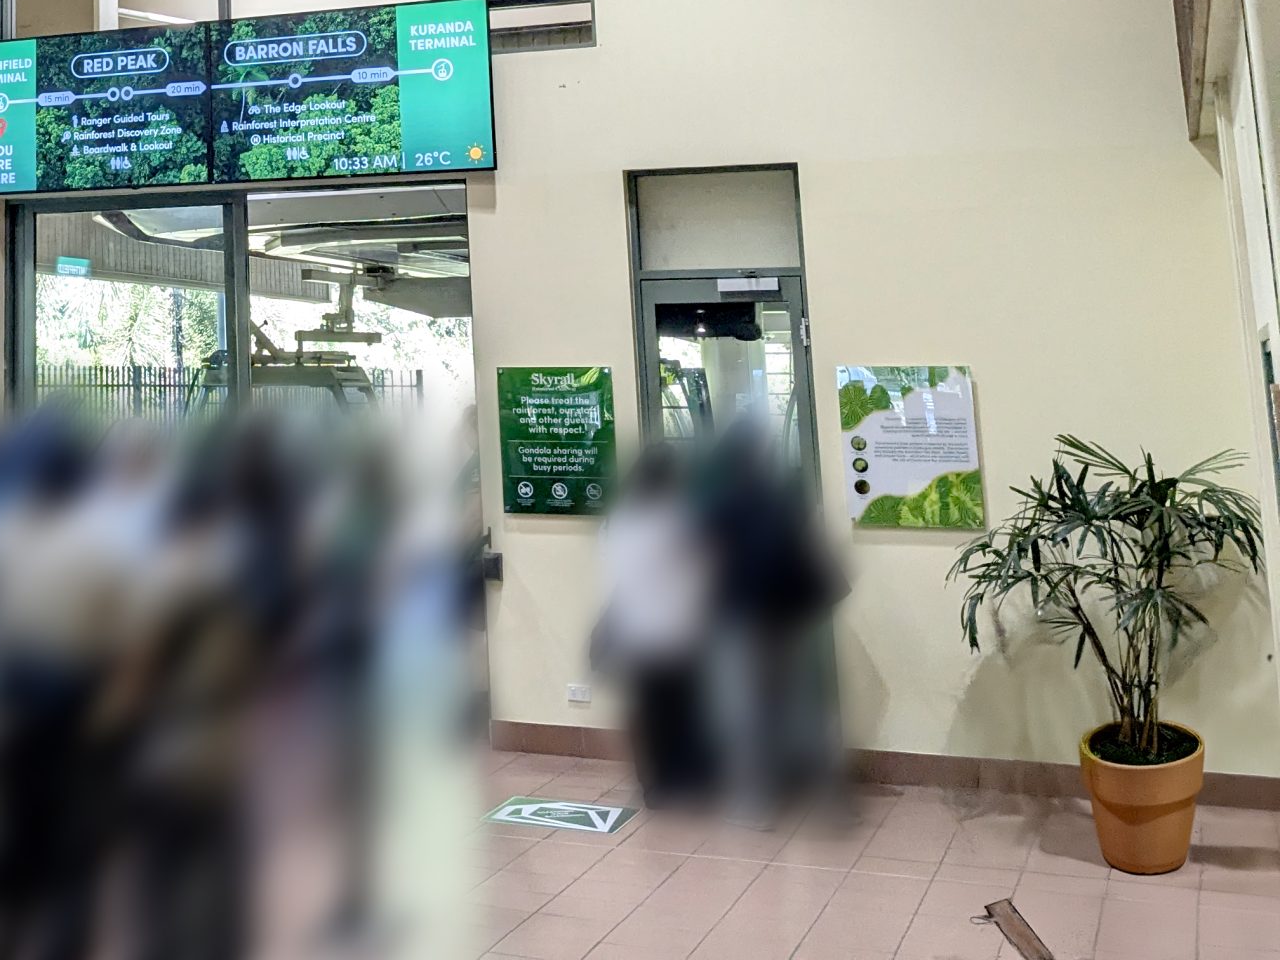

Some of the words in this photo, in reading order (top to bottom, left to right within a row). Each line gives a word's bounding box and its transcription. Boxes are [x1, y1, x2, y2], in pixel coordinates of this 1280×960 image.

[410, 21, 473, 36] KURANDA
[235, 41, 304, 60] BARRON
[309, 37, 356, 55] FALLS
[409, 35, 476, 51] TERMINAL
[83, 58, 113, 73] RED
[118, 54, 157, 70] PEAK
[358, 71, 367, 80] 10
[370, 70, 388, 79] min
[184, 84, 200, 92] min
[55, 93, 70, 102] min
[264, 105, 280, 113] The
[283, 103, 306, 114] Edge
[310, 100, 346, 110] Lookout
[81, 116, 112, 127] Ranger
[114, 114, 144, 123] Guided
[147, 113, 169, 121] Tours
[232, 120, 277, 131] Rainforest
[280, 116, 341, 129] Interpretation
[345, 114, 376, 124] Centre
[74, 130, 115, 140] Rainforest
[117, 128, 158, 138] Discovery
[160, 126, 182, 135] Zone
[263, 133, 305, 143] Historical
[308, 131, 344, 141] Precinct
[83, 144, 128, 154] Boardwalk
[130, 143, 136, 151] &
[139, 141, 172, 151] Lookout
[334, 157, 368, 170] 10:33
[373, 155, 397, 167] AM
[415, 151, 451, 166] 26°C
[520, 416, 536, 424] and
[539, 416, 561, 424] other
[529, 426, 547, 434] with
[550, 427, 584, 435] respect.
[553, 447, 582, 456] sharing
[569, 456, 594, 464] during
[533, 464, 550, 472] busy
[553, 464, 584, 472] periods.
